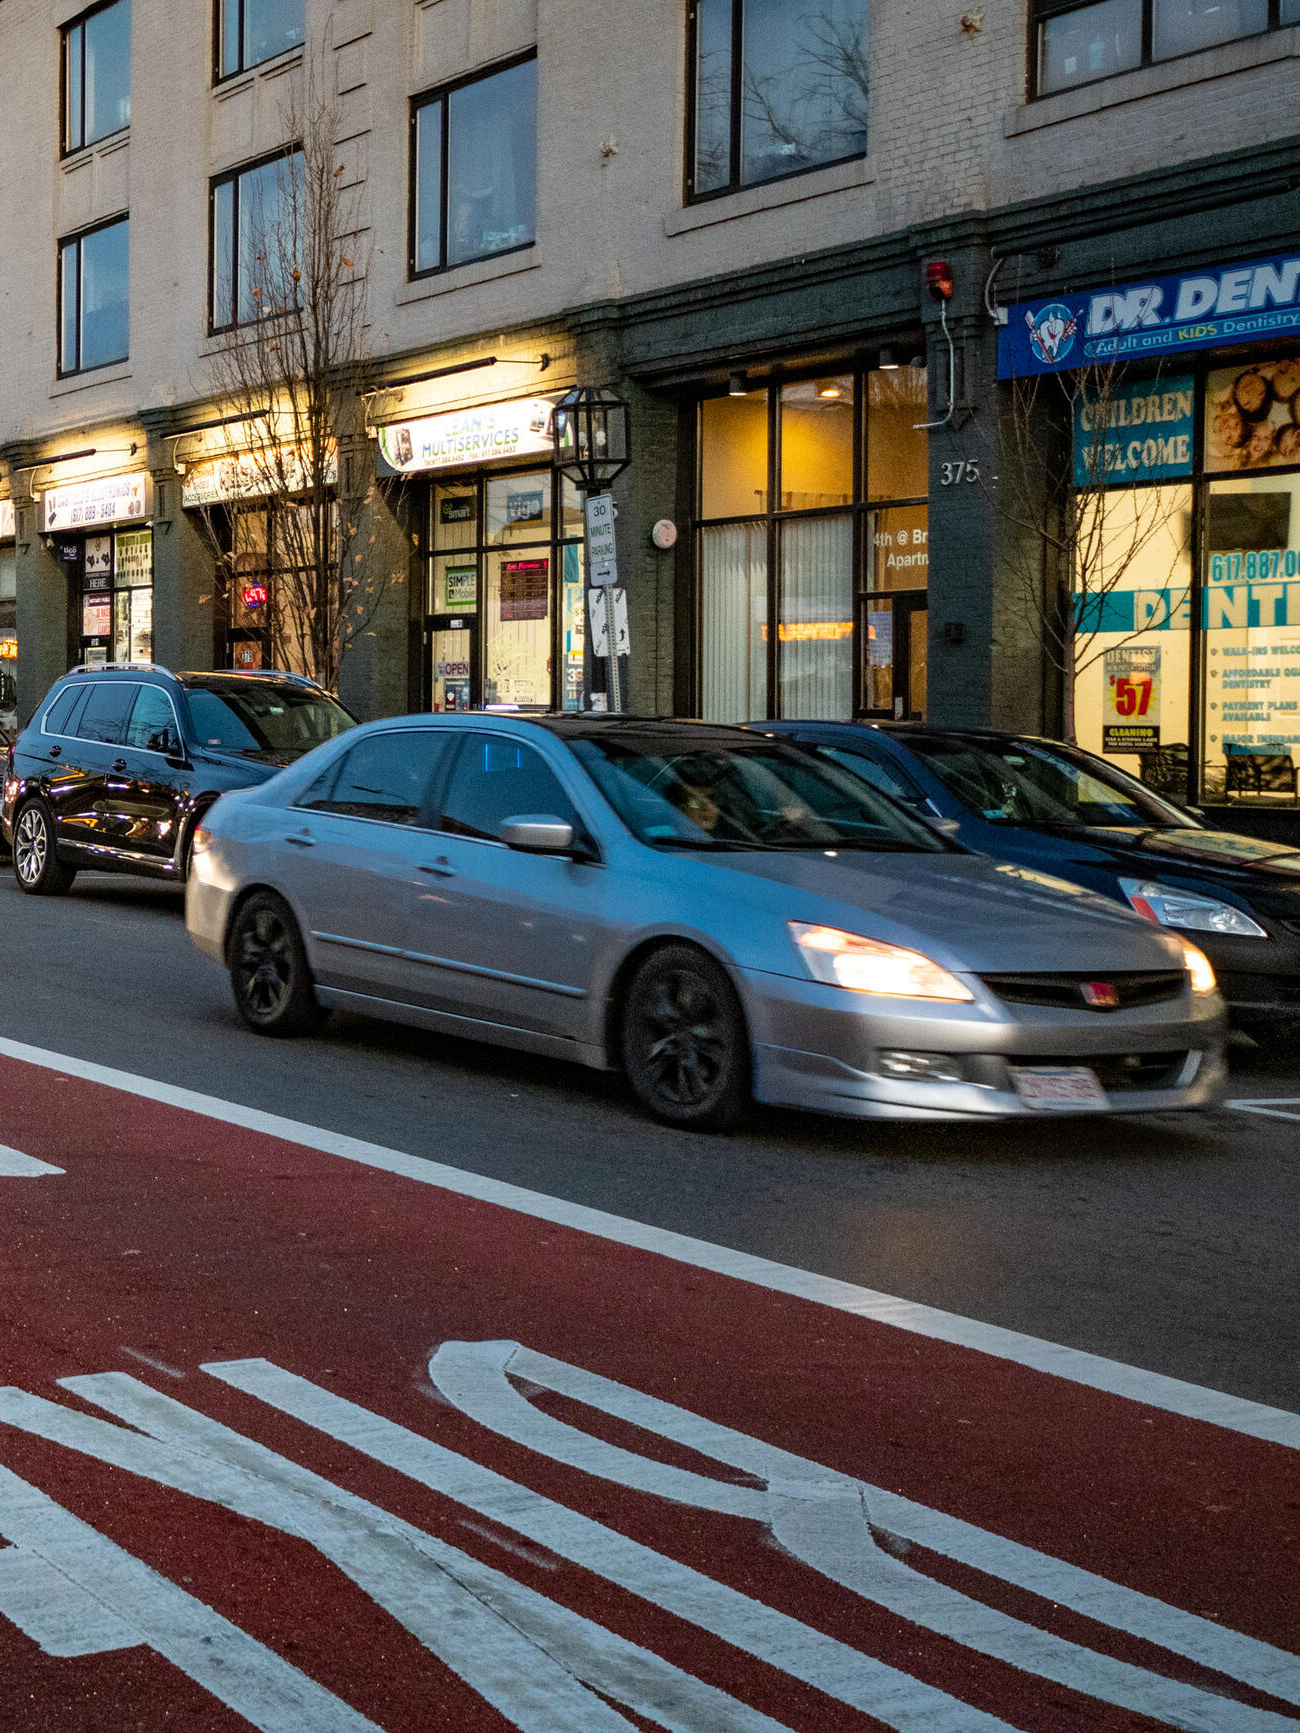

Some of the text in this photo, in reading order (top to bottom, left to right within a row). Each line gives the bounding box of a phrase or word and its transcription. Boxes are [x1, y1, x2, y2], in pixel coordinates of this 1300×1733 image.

[1086, 259, 1300, 335] DR. DEN
[1095, 314, 1299, 355] Adult and KIDS Dentistry
[1081, 390, 1193, 432] CHILDREN
[421, 426, 520, 459] MULTISERVICES
[1082, 434, 1191, 472] WELCOME
[940, 459, 980, 486] 375
[593, 504, 606, 517] 30
[590, 523, 611, 537] MINUTE
[874, 532, 893, 547] 4th
[897, 530, 908, 545] @
[591, 542, 614, 557] PARKING
[1211, 550, 1300, 582] 617.887.0
[89, 578, 107, 588] HERE
[448, 574, 475, 588] SIMPLE
[455, 589, 475, 600] Mobile
[1134, 583, 1300, 631] DENT
[1222, 647, 1268, 656] WALK-INS
[445, 662, 469, 675] OPEN
[1222, 668, 1280, 678] AFFORDABLE
[1222, 680, 1271, 688] DENTISTRY
[1222, 701, 1298, 710] PAYMENT PLANS
[1222, 712, 1271, 721] AVAILABLE
[1109, 728, 1154, 737] CLEANING
[1222, 734, 1254, 743] MAJOR
